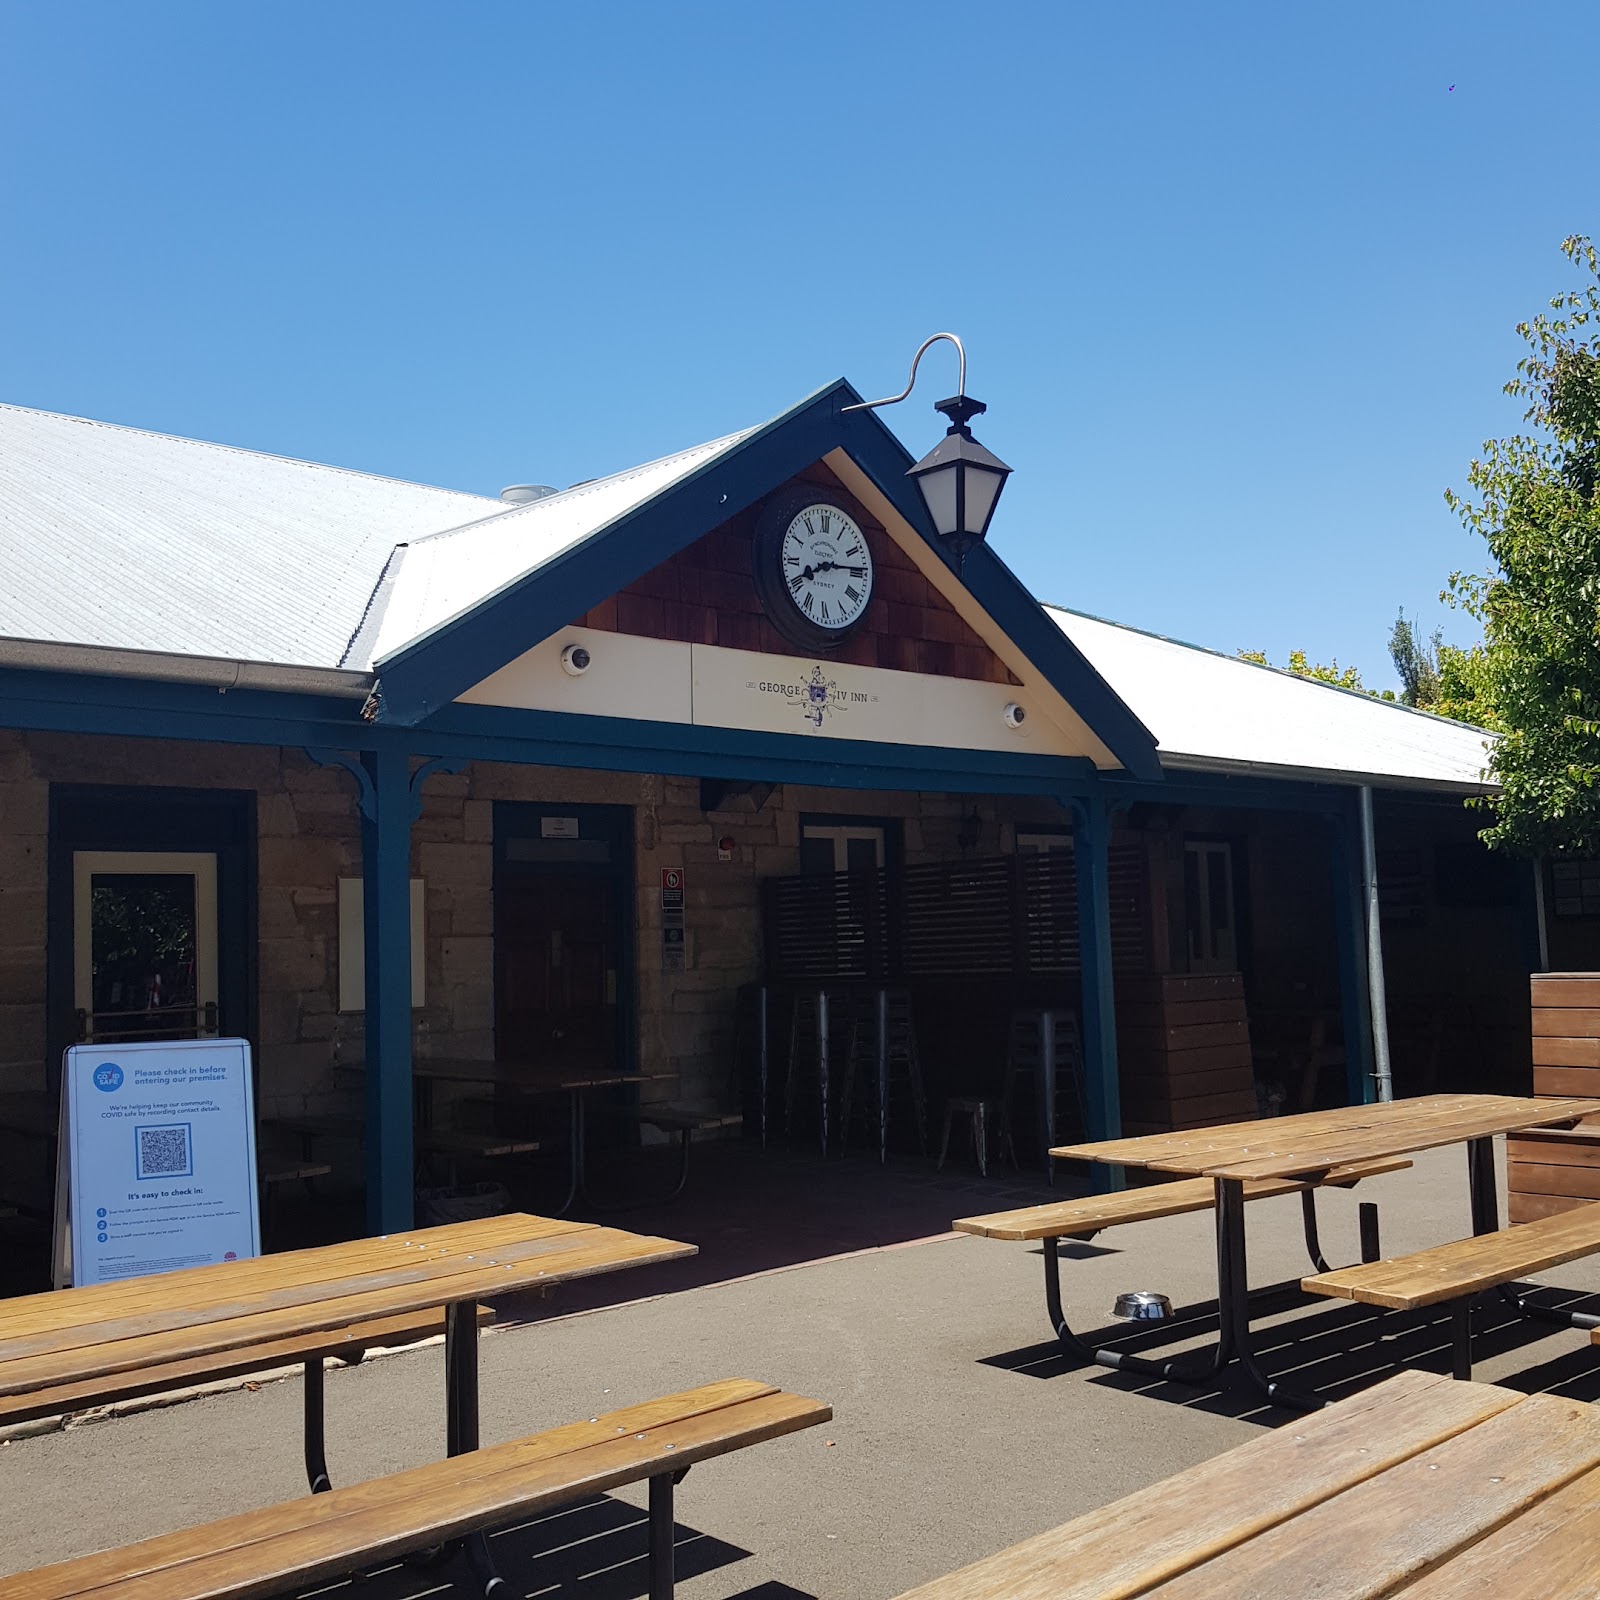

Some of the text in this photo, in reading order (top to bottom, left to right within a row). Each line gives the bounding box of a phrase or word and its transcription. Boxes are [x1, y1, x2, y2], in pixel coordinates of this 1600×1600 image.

[819, 515, 831, 534] XII
[813, 580, 835, 589] SYDNEY
[759, 681, 800, 698] GEORGE
[837, 690, 847, 701] IV
[850, 692, 868, 703] INN
[134, 1065, 227, 1077] Please check in before
[99, 1078, 119, 1086] SAFE
[134, 1076, 170, 1086] entering
[188, 1073, 228, 1084] premises.
[129, 1103, 152, 1111] helping
[138, 1109, 146, 1117] by
[147, 1108, 176, 1116] recording
[127, 1192, 140, 1200] It's
[141, 1191, 159, 1200] easy
[171, 1188, 192, 1196] check
[193, 1187, 204, 1195] in:
